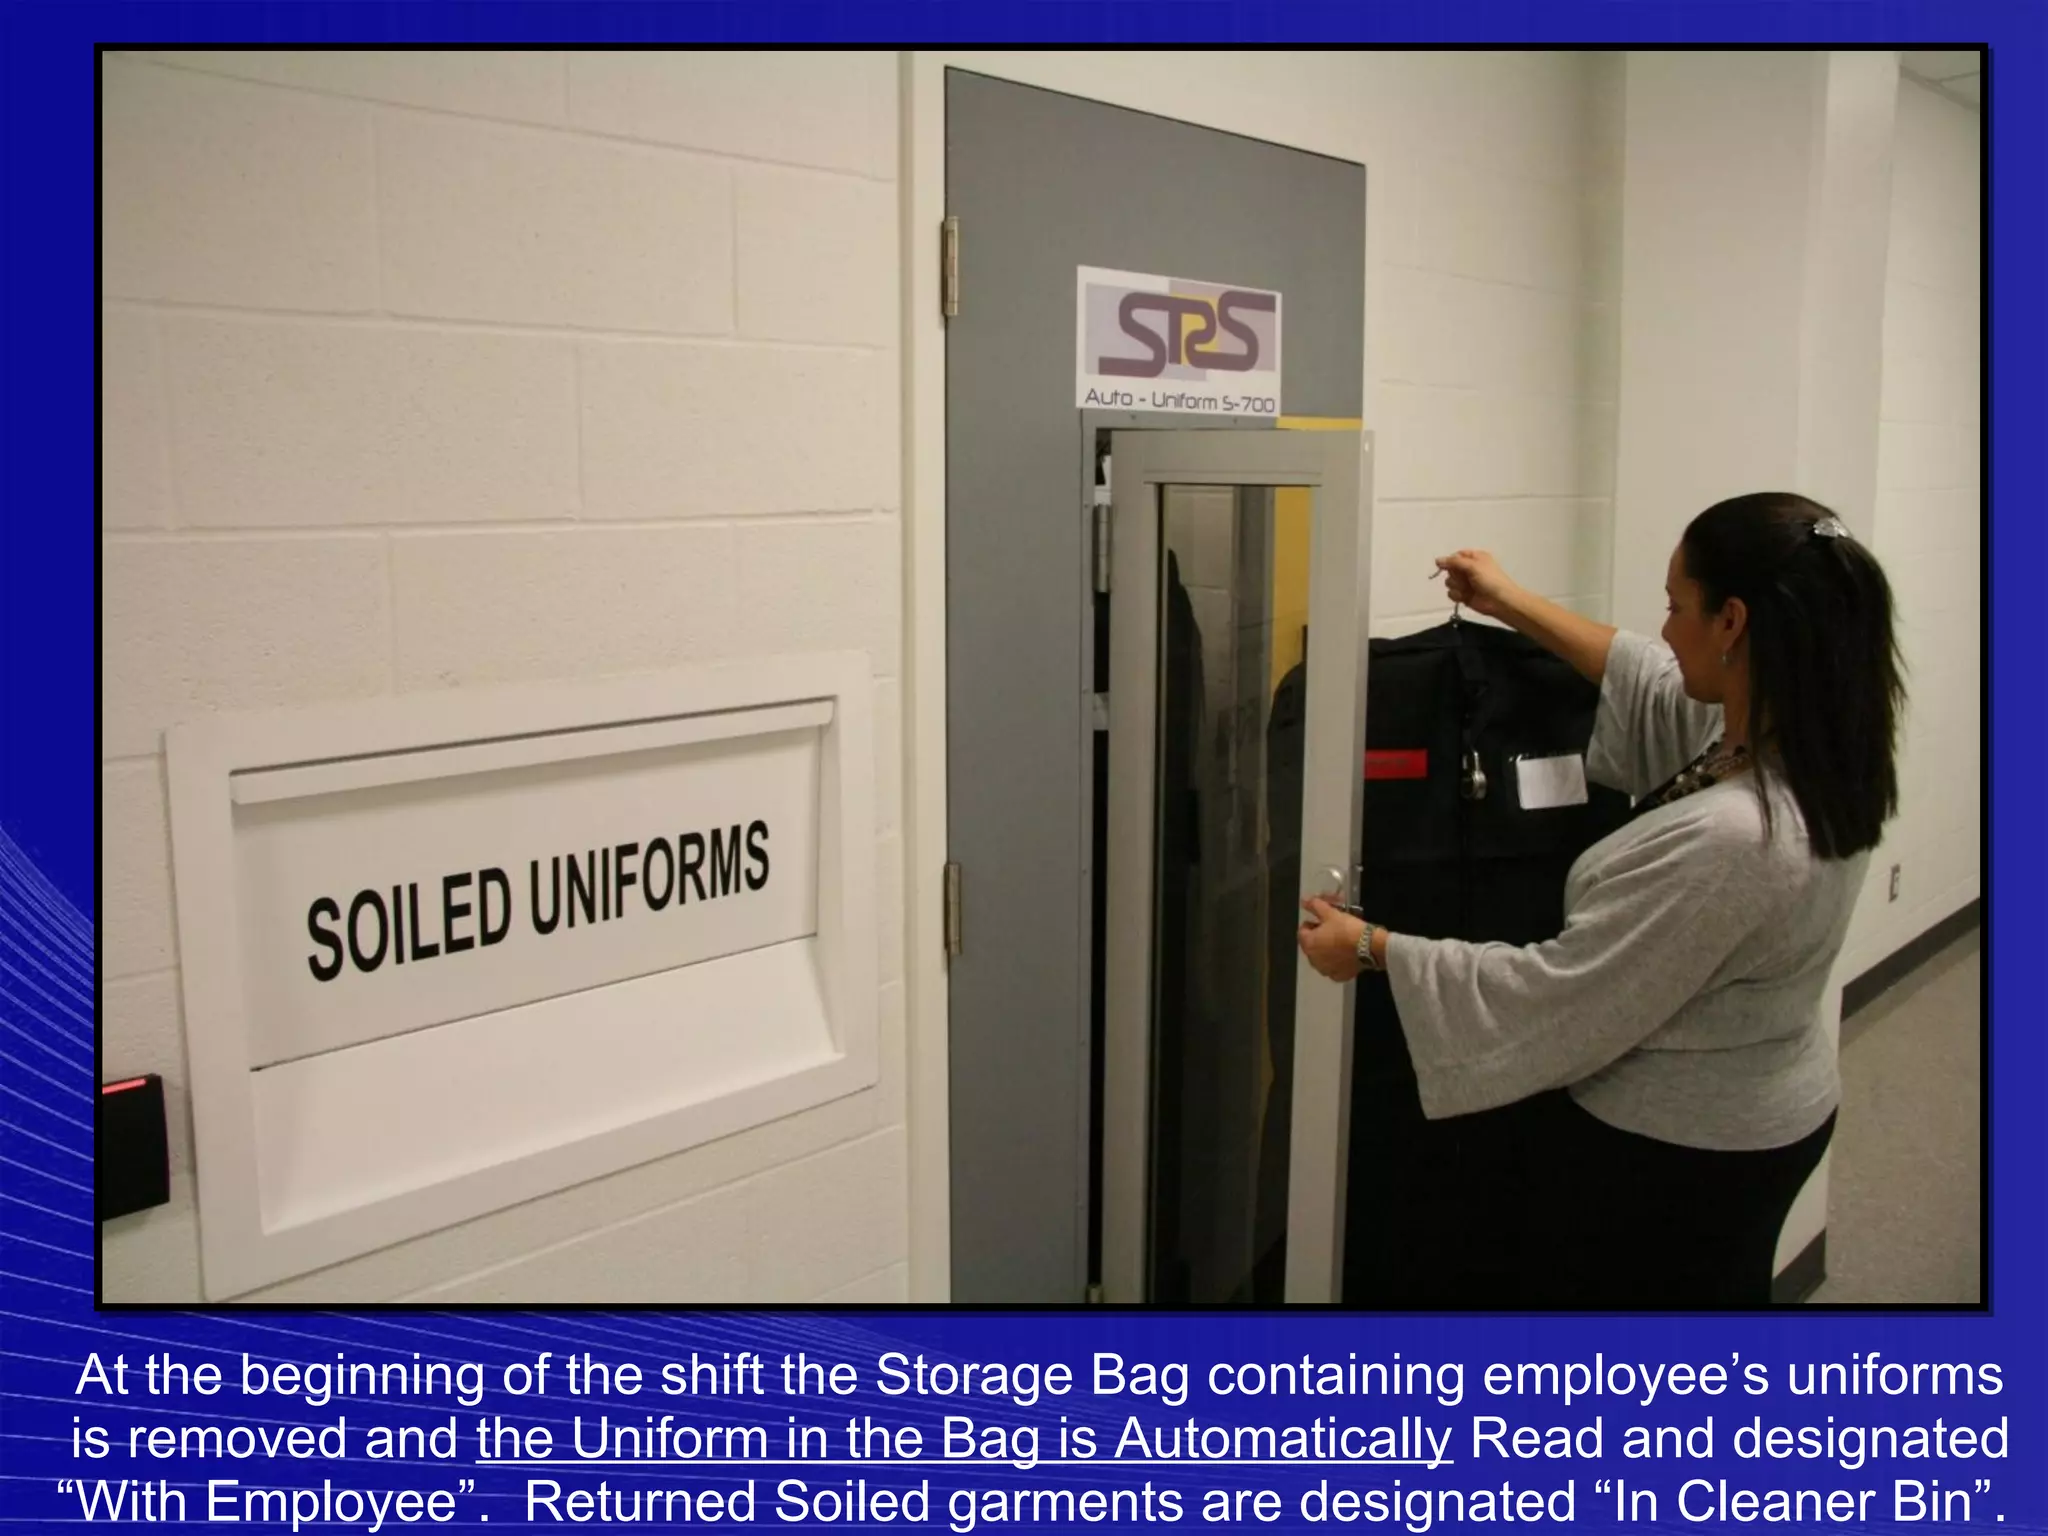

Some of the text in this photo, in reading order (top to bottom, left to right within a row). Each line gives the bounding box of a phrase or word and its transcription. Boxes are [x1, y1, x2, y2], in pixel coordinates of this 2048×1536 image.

[1085, 388, 1133, 407] Auto
[1152, 391, 1218, 411] Uniform
[1222, 396, 1275, 413] S-700
[307, 819, 770, 982] SOILED UNIFORMS
